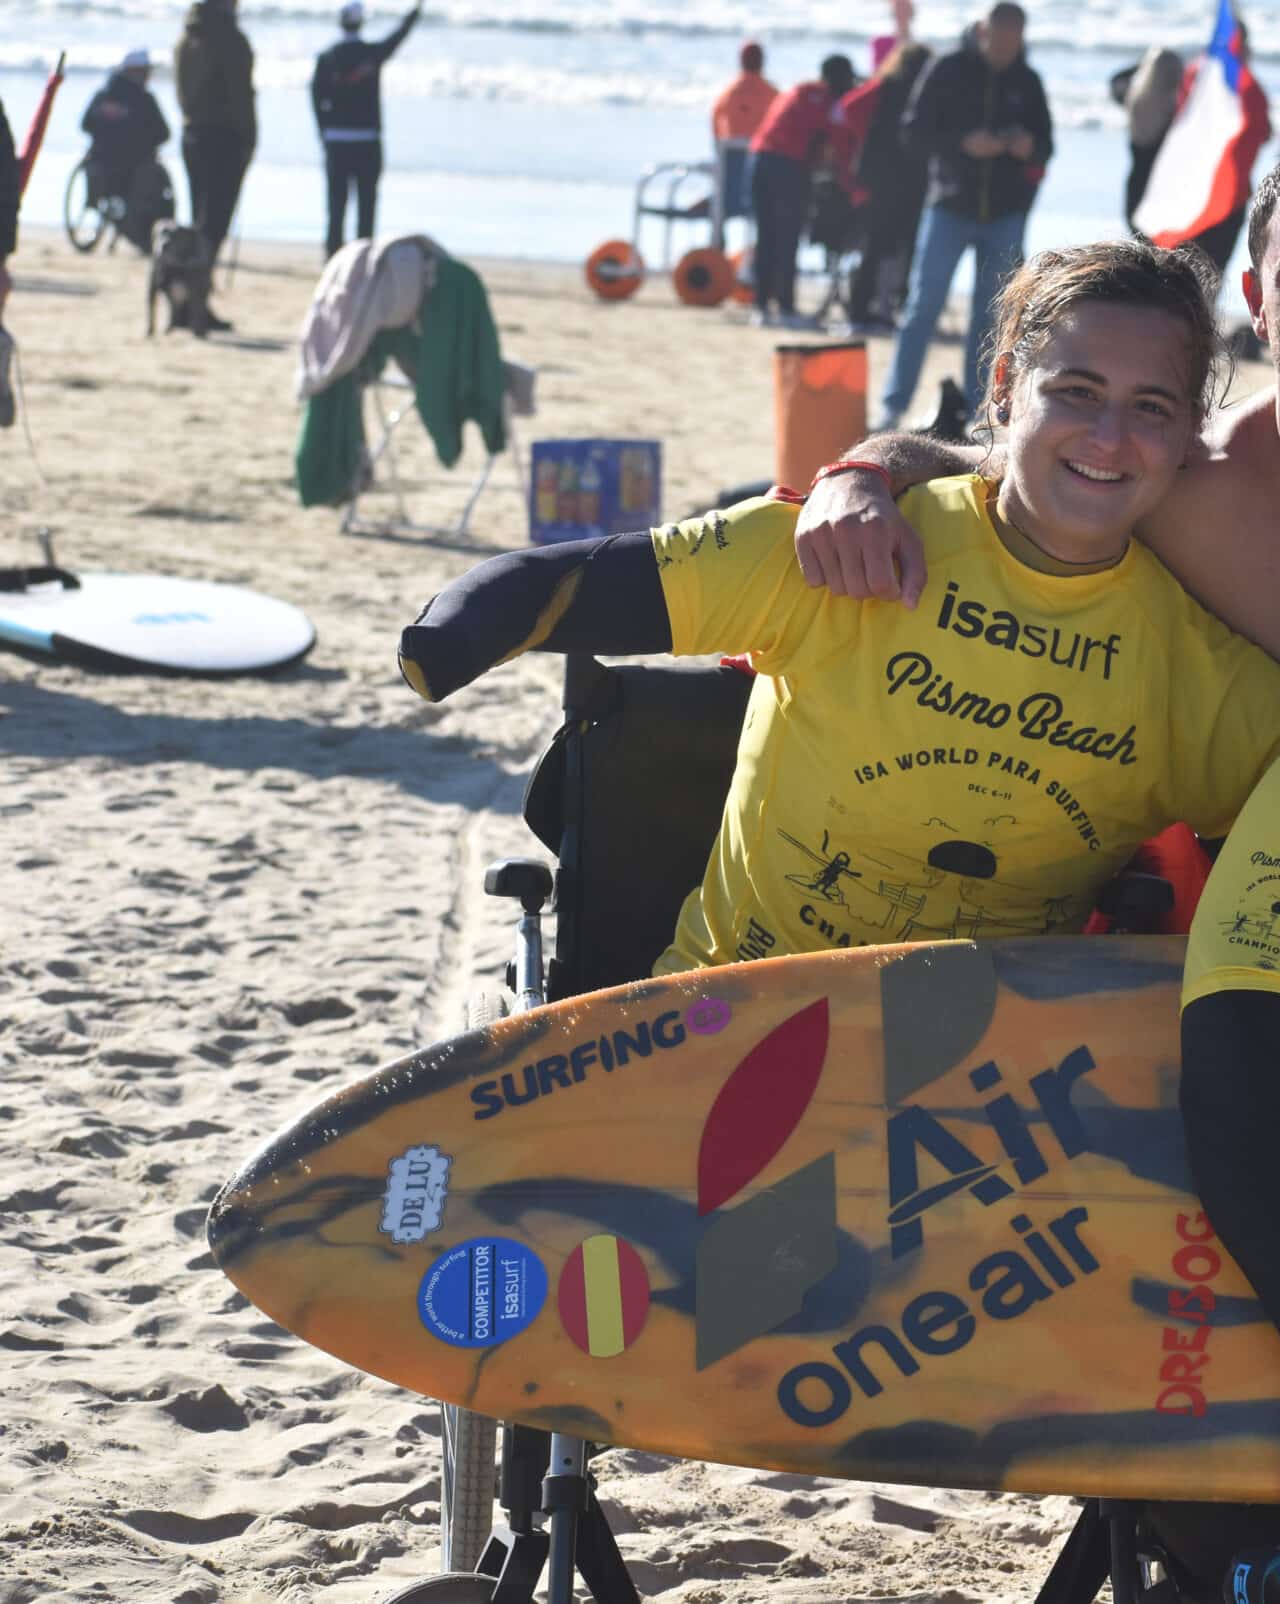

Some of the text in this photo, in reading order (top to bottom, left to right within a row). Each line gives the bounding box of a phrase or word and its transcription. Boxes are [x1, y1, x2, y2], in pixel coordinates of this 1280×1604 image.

[937, 581, 1121, 680] isasurf
[886, 652, 1138, 766] Pismo Beach
[854, 748, 1100, 851] ISA WORLD PARA SURFING
[470, 1011, 687, 1121] SURFING
[887, 1044, 1096, 1261] Air
[424, 1271, 441, 1301] through
[475, 1246, 490, 1340] COMPETITOR
[500, 1259, 519, 1319] isasurf
